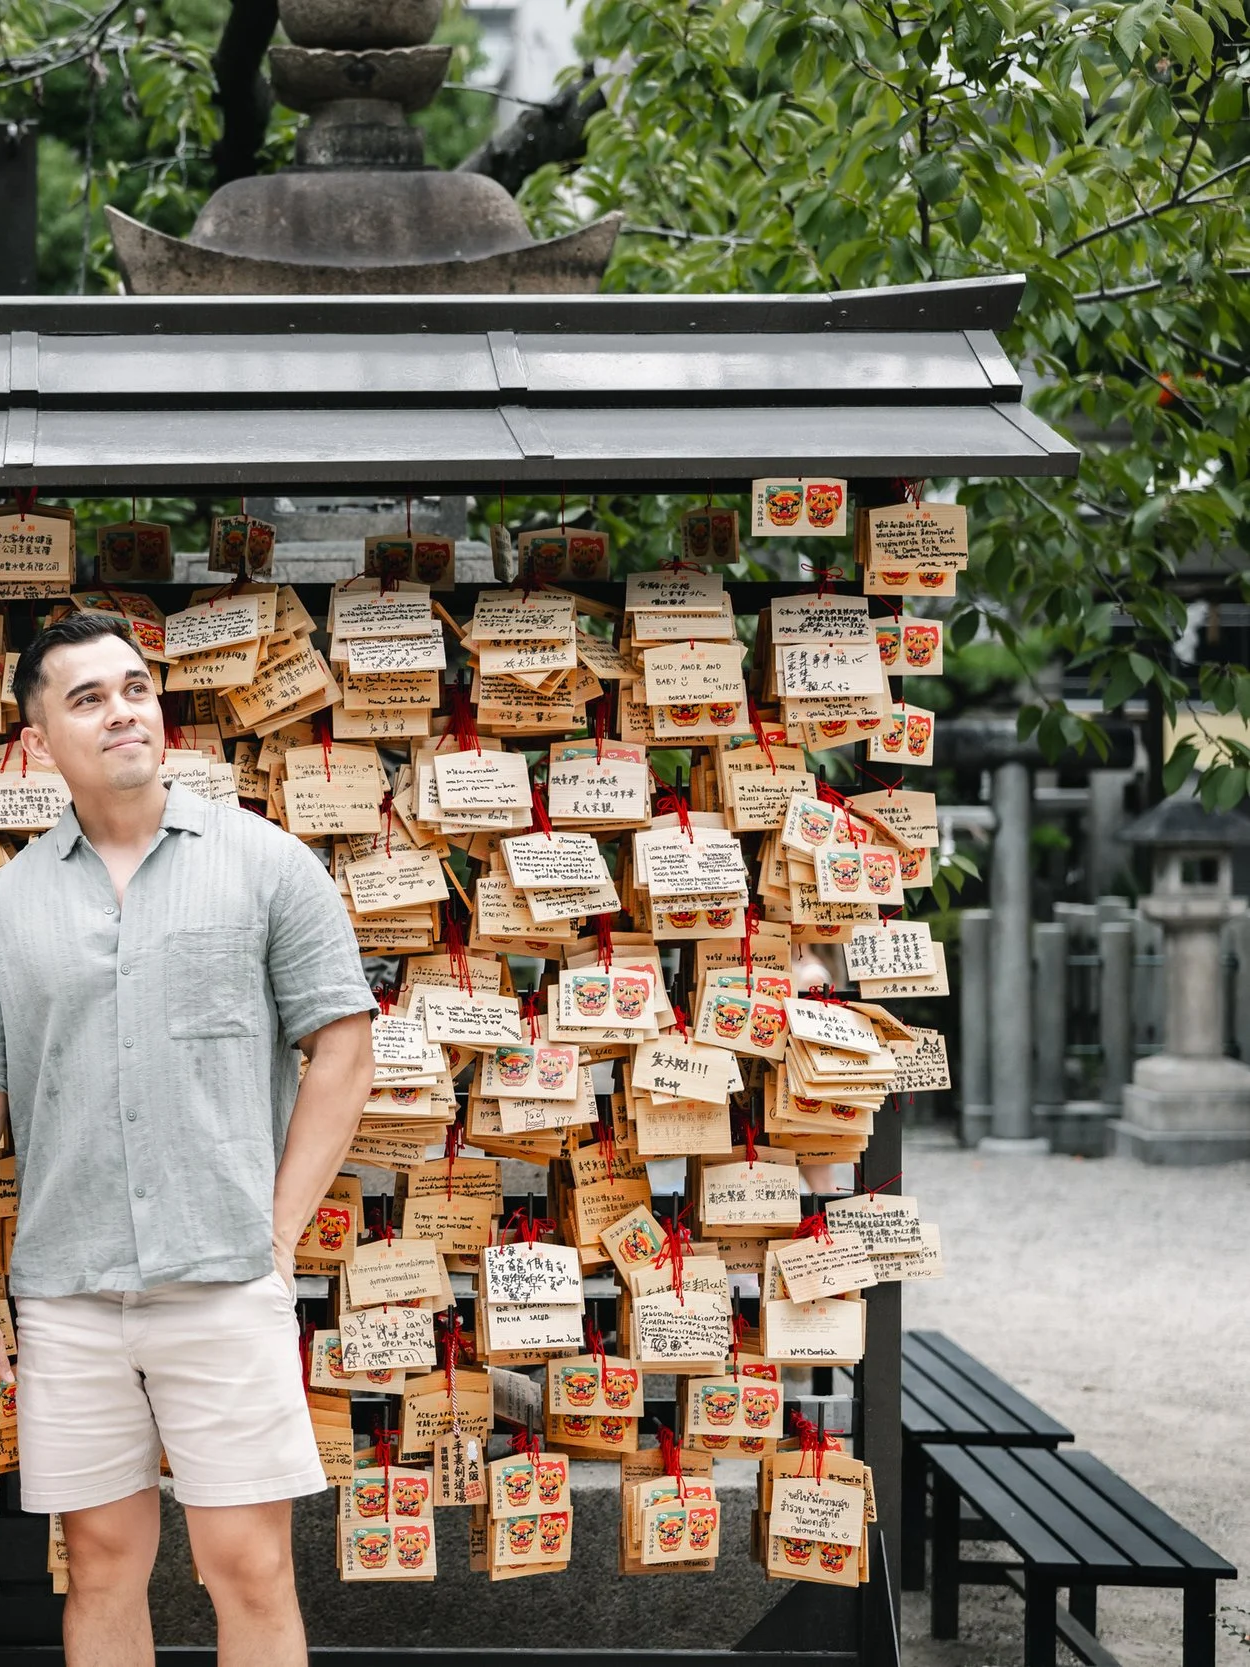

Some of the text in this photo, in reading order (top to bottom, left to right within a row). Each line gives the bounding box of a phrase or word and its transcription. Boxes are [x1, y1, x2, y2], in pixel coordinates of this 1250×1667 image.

[680, 663, 701, 671] AMOR
[464, 1012, 487, 1020] happy
[452, 1440, 467, 1503] 手裏剣道場
[468, 1460, 479, 1481] 大阪
